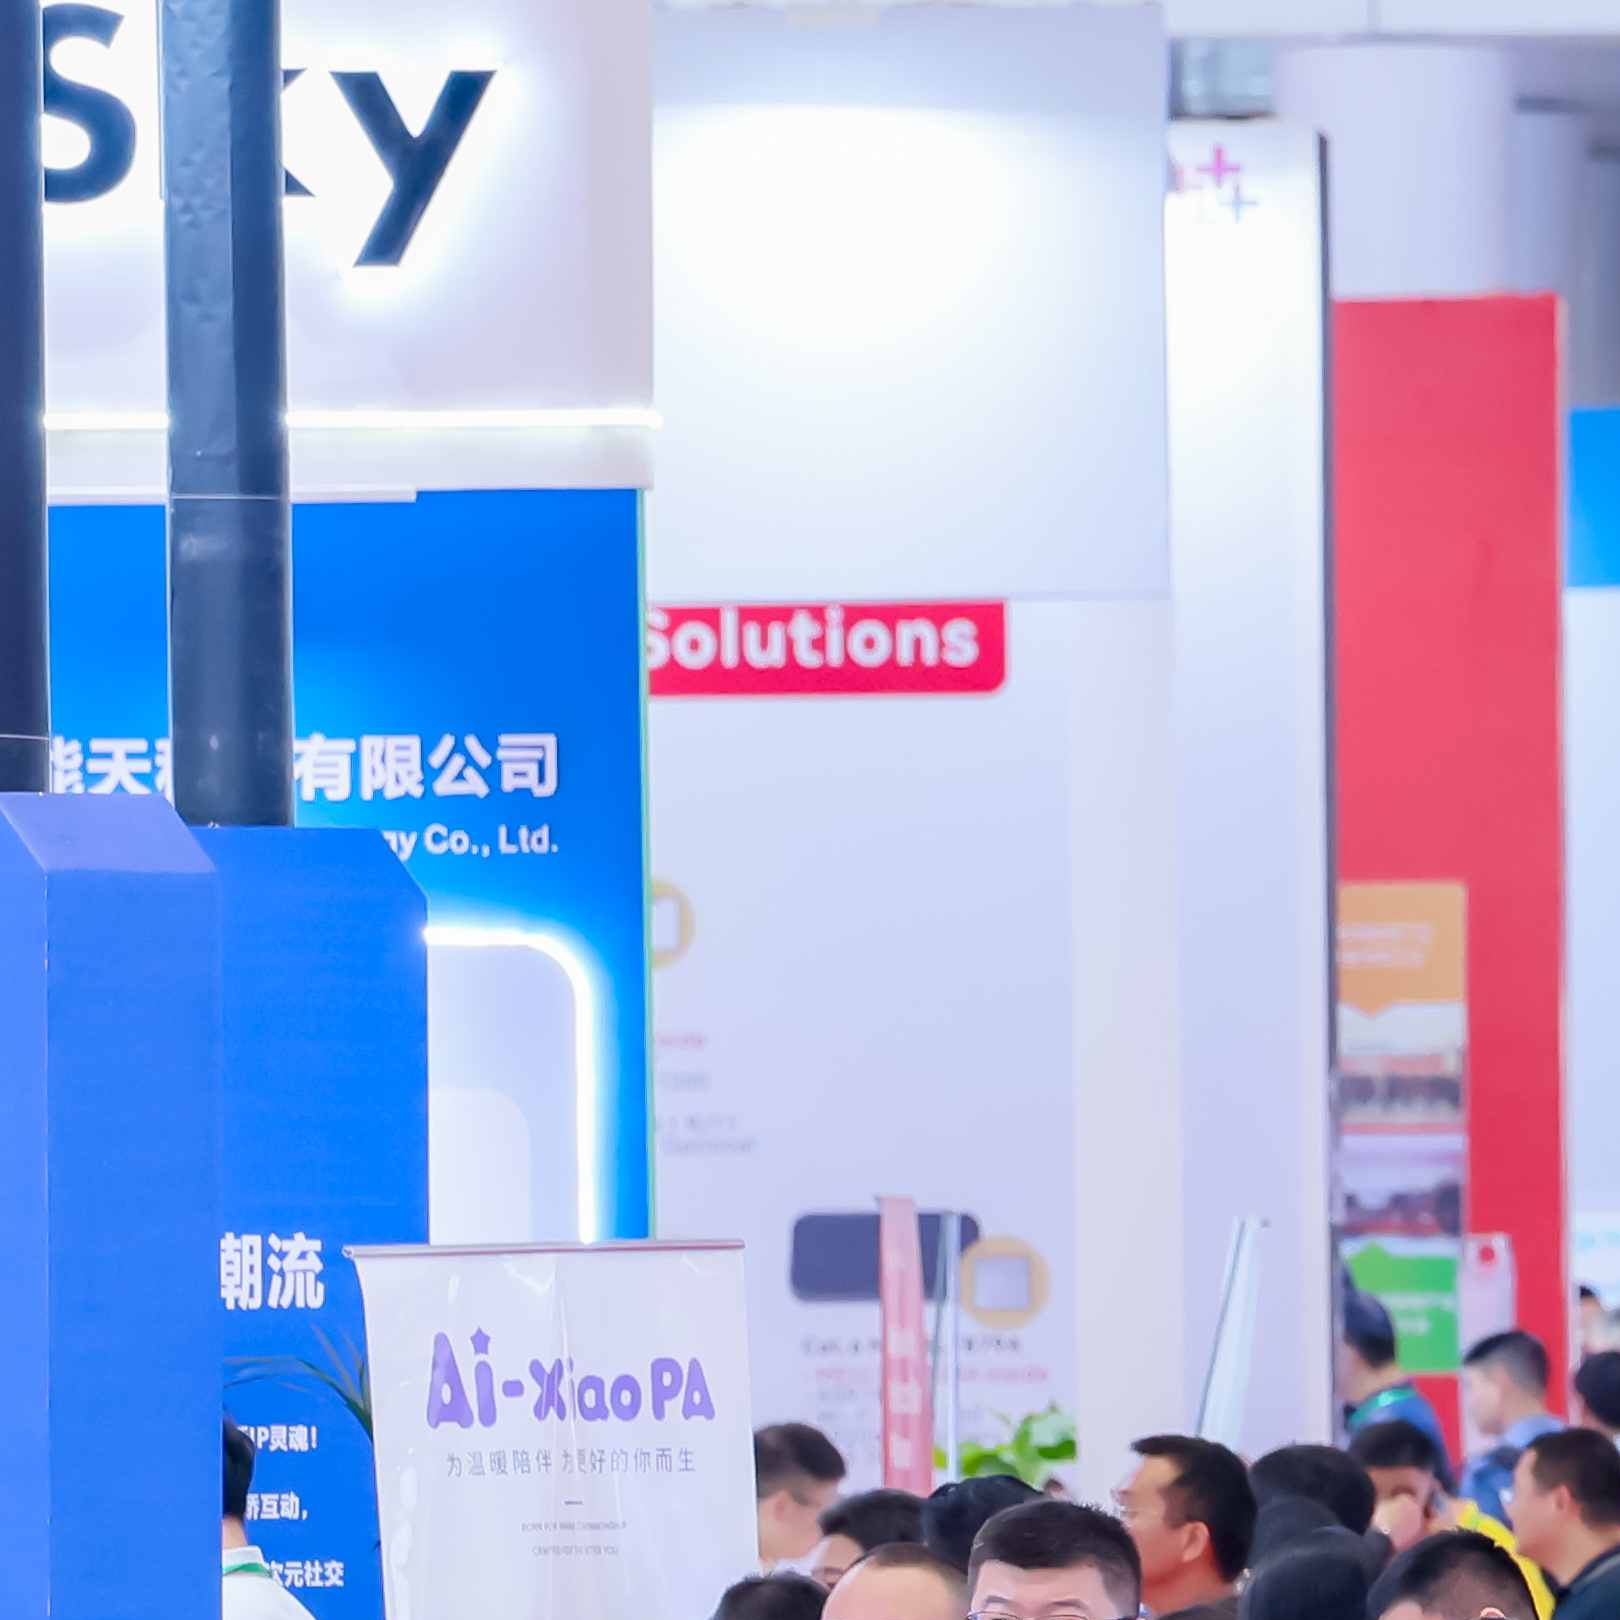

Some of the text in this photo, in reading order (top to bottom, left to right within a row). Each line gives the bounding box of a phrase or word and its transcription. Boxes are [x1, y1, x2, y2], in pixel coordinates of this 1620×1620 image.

[646, 604, 980, 670] Solutions
[423, 824, 491, 856] Co.,
[498, 823, 559, 855] Ltd.
